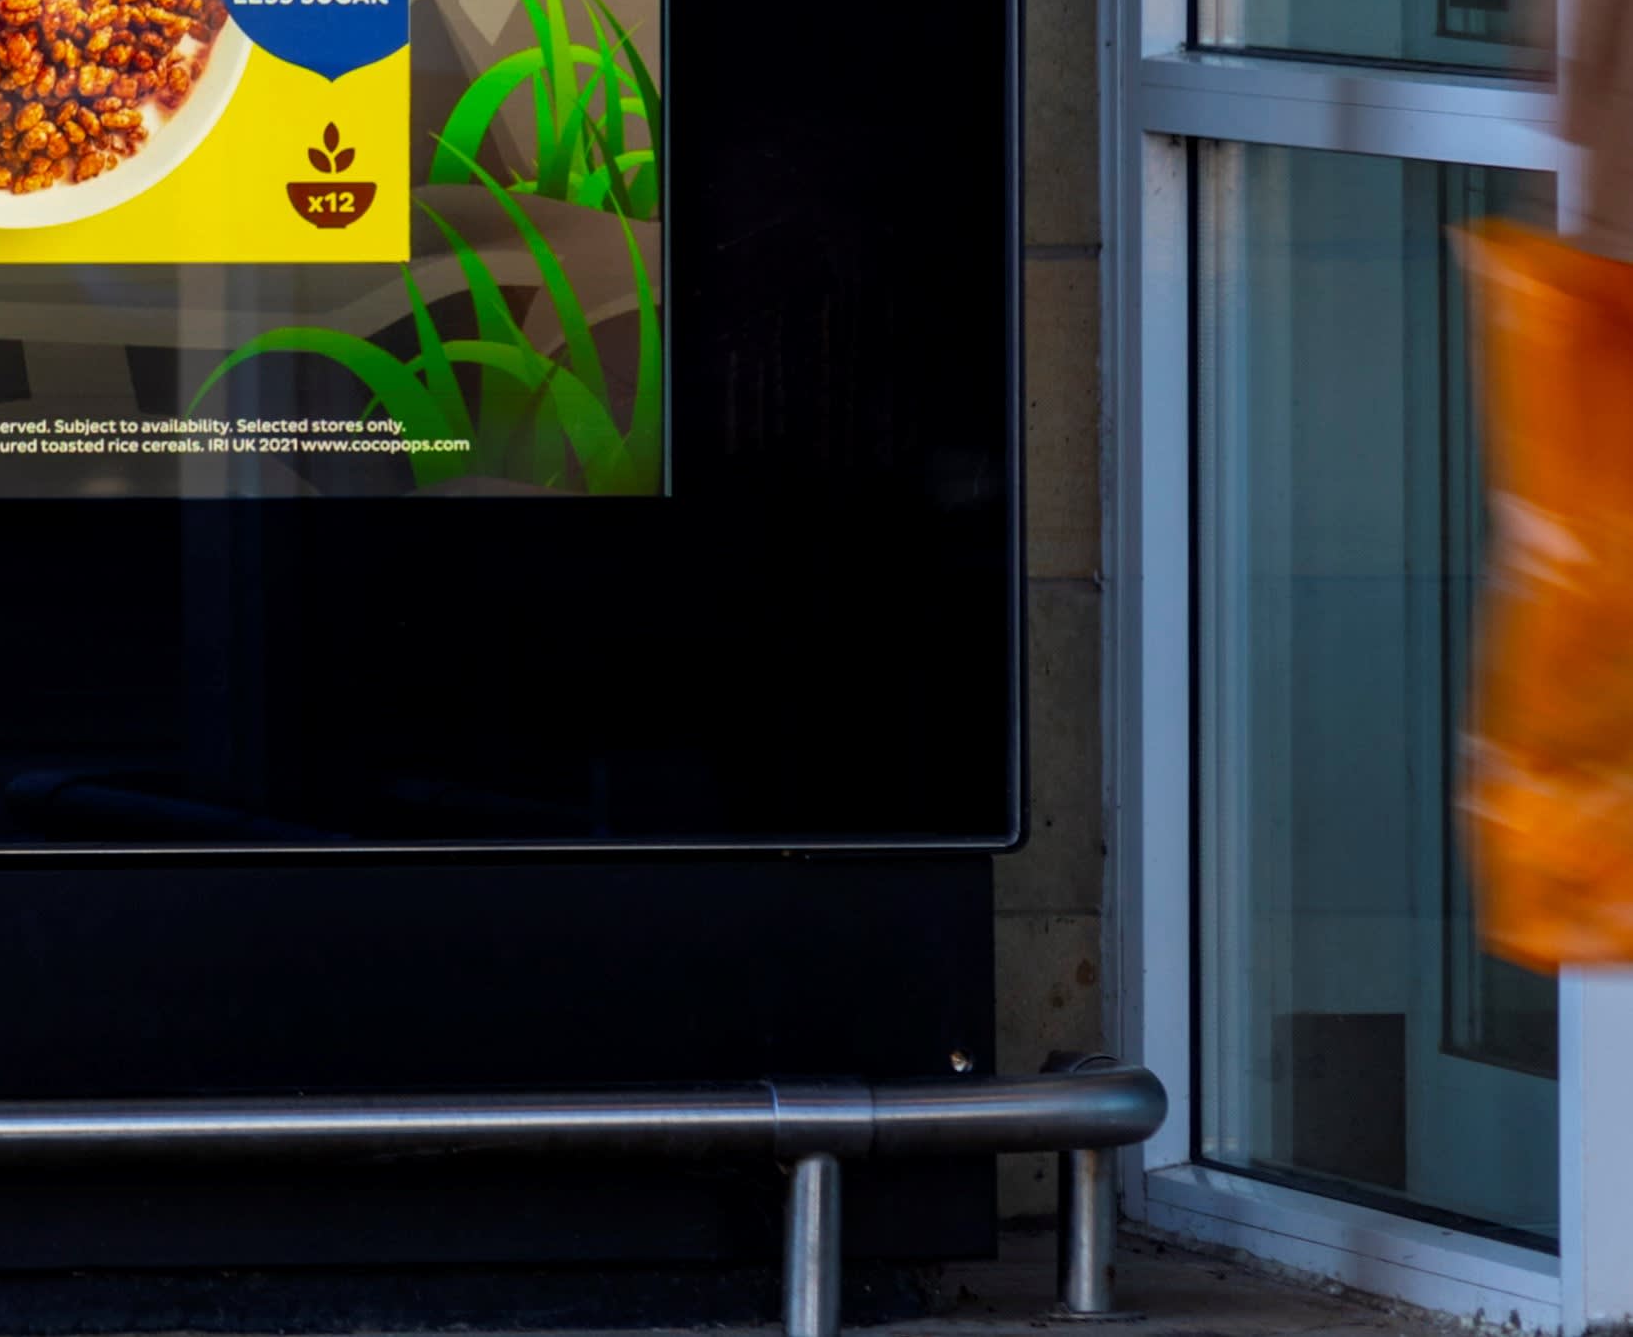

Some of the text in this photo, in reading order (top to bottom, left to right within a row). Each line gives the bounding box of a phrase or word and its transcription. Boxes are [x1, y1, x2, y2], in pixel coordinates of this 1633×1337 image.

[308, 192, 355, 214] x12
[55, 419, 116, 436] Subject
[120, 420, 138, 433] to
[141, 419, 233, 436] availability.
[237, 419, 308, 433] Selected
[312, 420, 363, 433] stores
[367, 419, 405, 436] only.
[41, 438, 104, 452] toasted
[108, 438, 139, 452] rice
[142, 438, 205, 452] cereals.
[208, 438, 229, 452] IRI
[233, 438, 256, 452] UK
[259, 438, 297, 452] 2021
[301, 440, 469, 454] www.cocopops.com
